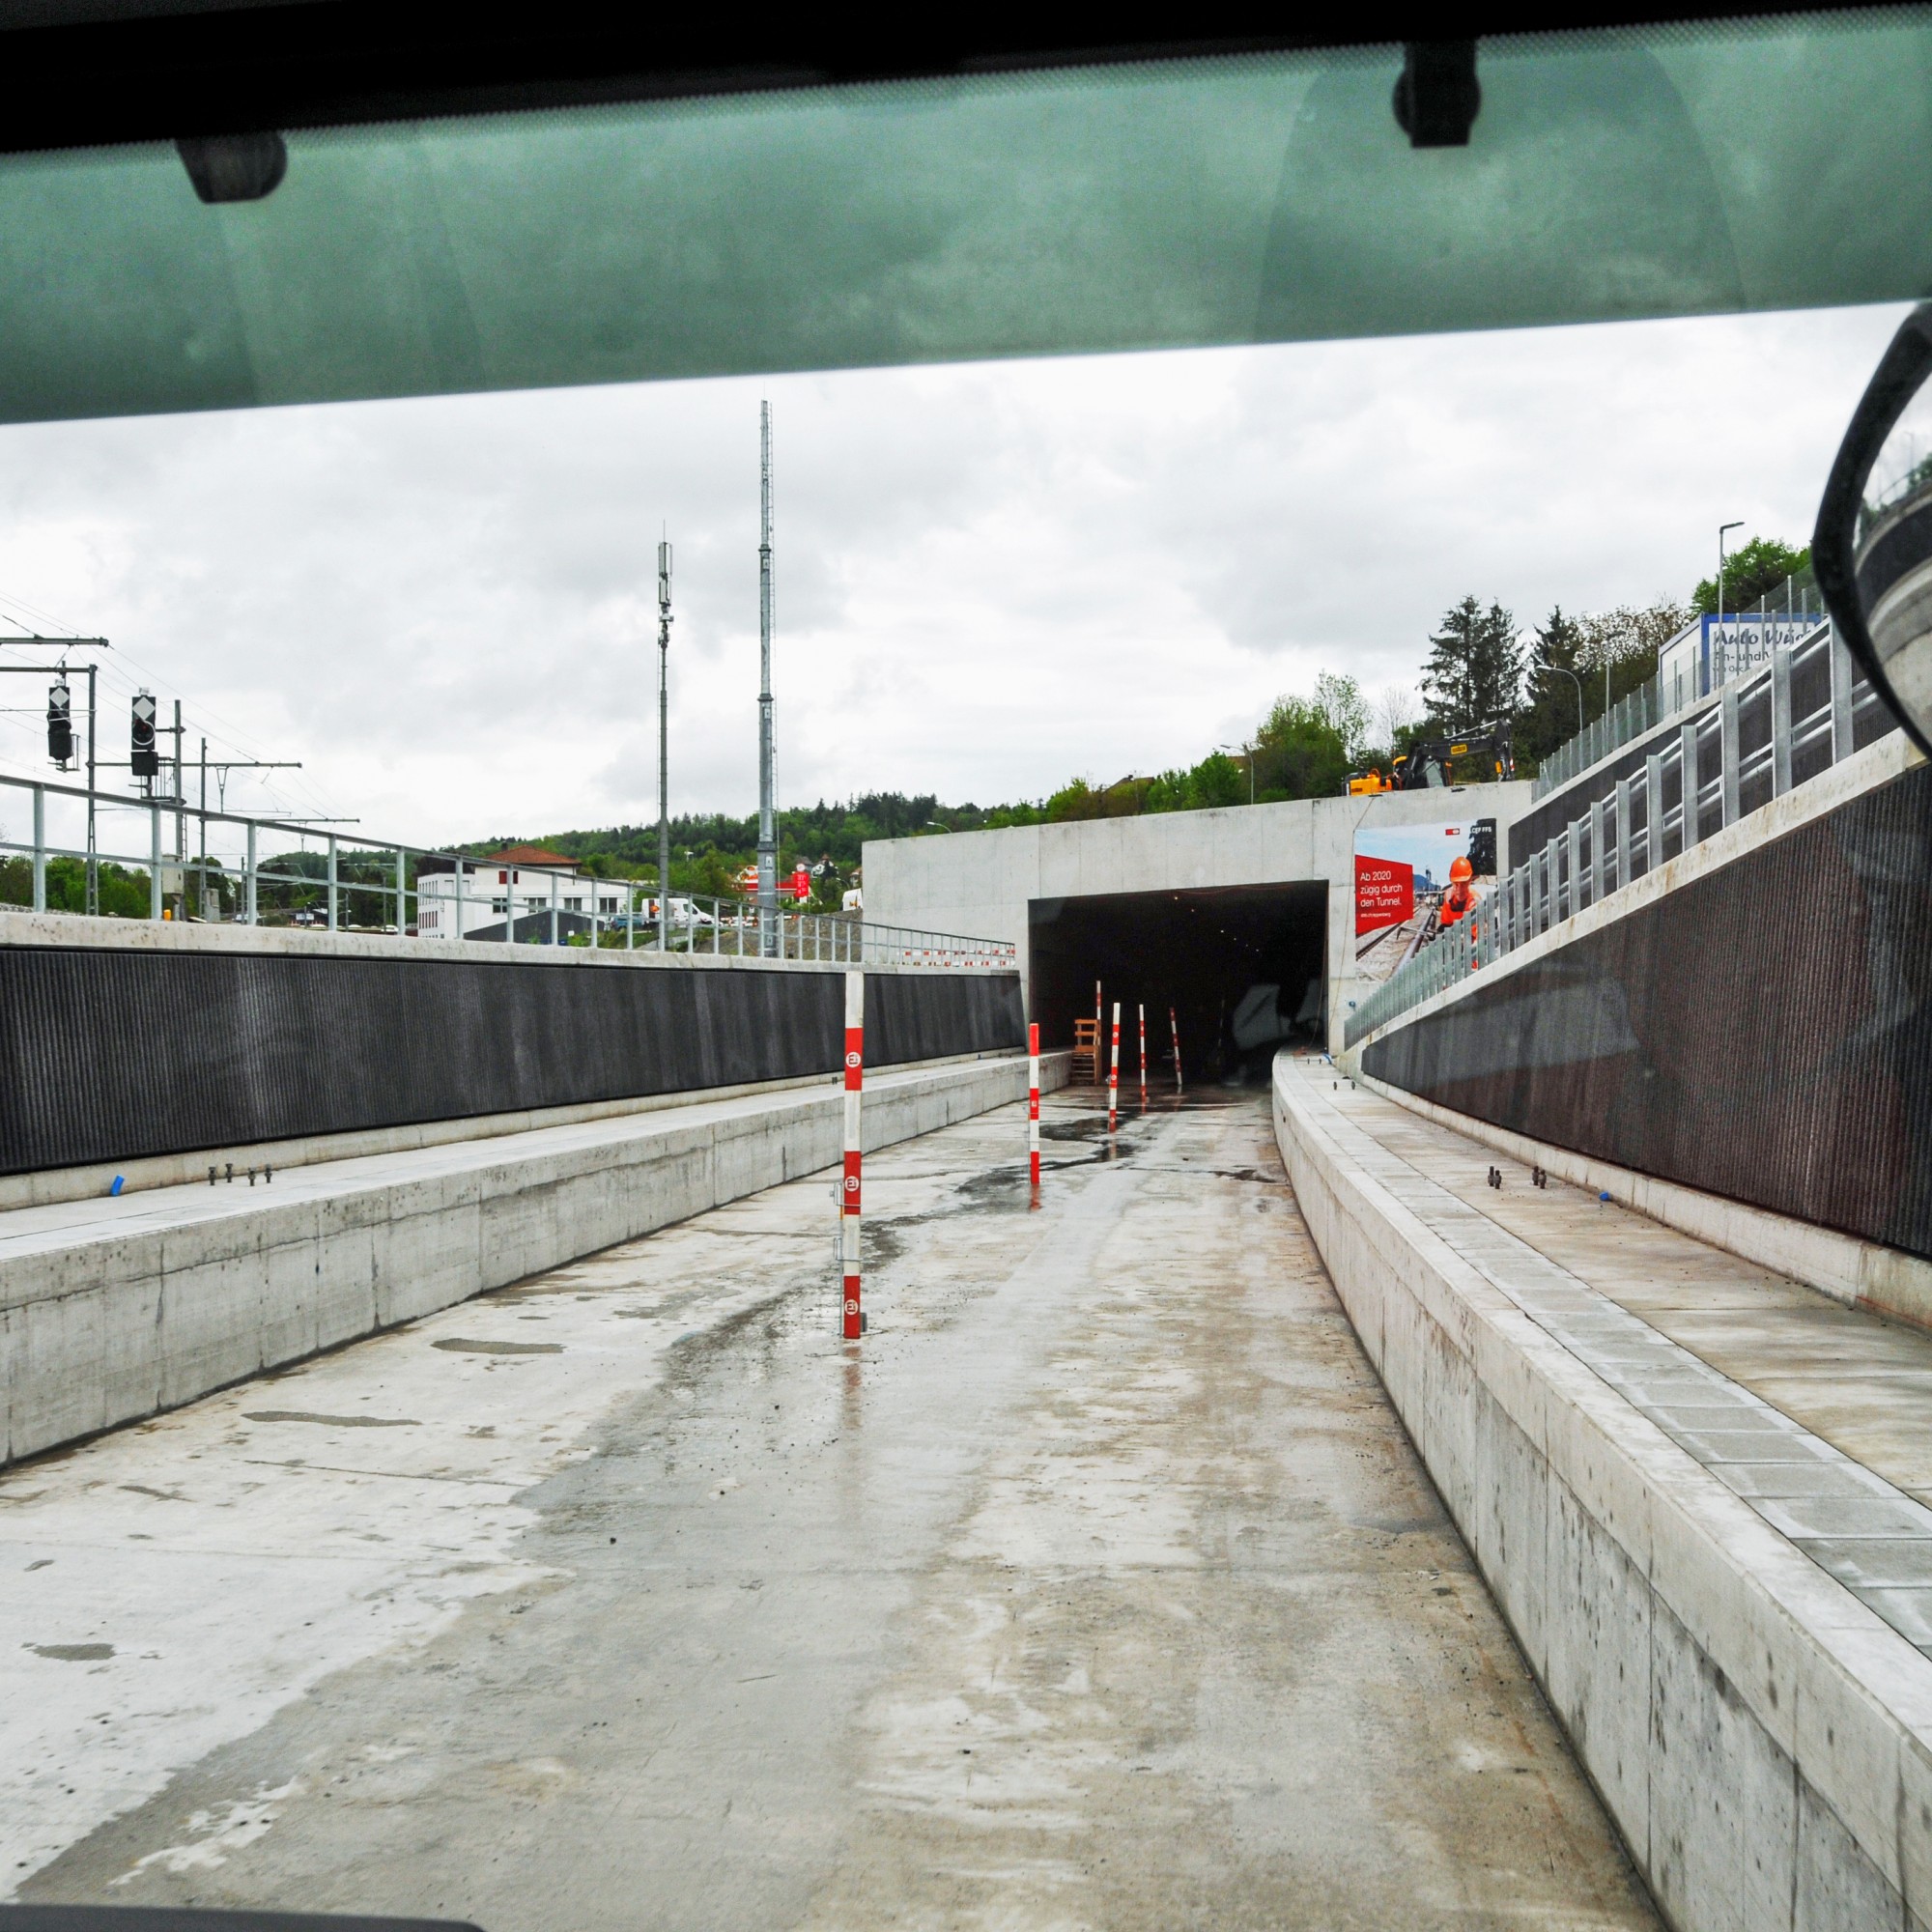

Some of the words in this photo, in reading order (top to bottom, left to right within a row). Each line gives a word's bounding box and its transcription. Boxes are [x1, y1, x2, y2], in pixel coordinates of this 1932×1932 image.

[1713, 628, 1759, 645] Auto
[1360, 872, 1371, 881] Ab
[1372, 870, 1391, 881] 2020
[1360, 885, 1379, 895] zügig
[1381, 884, 1403, 894] durch
[1360, 898, 1375, 907] den
[1376, 897, 1402, 906] Tunnel.
